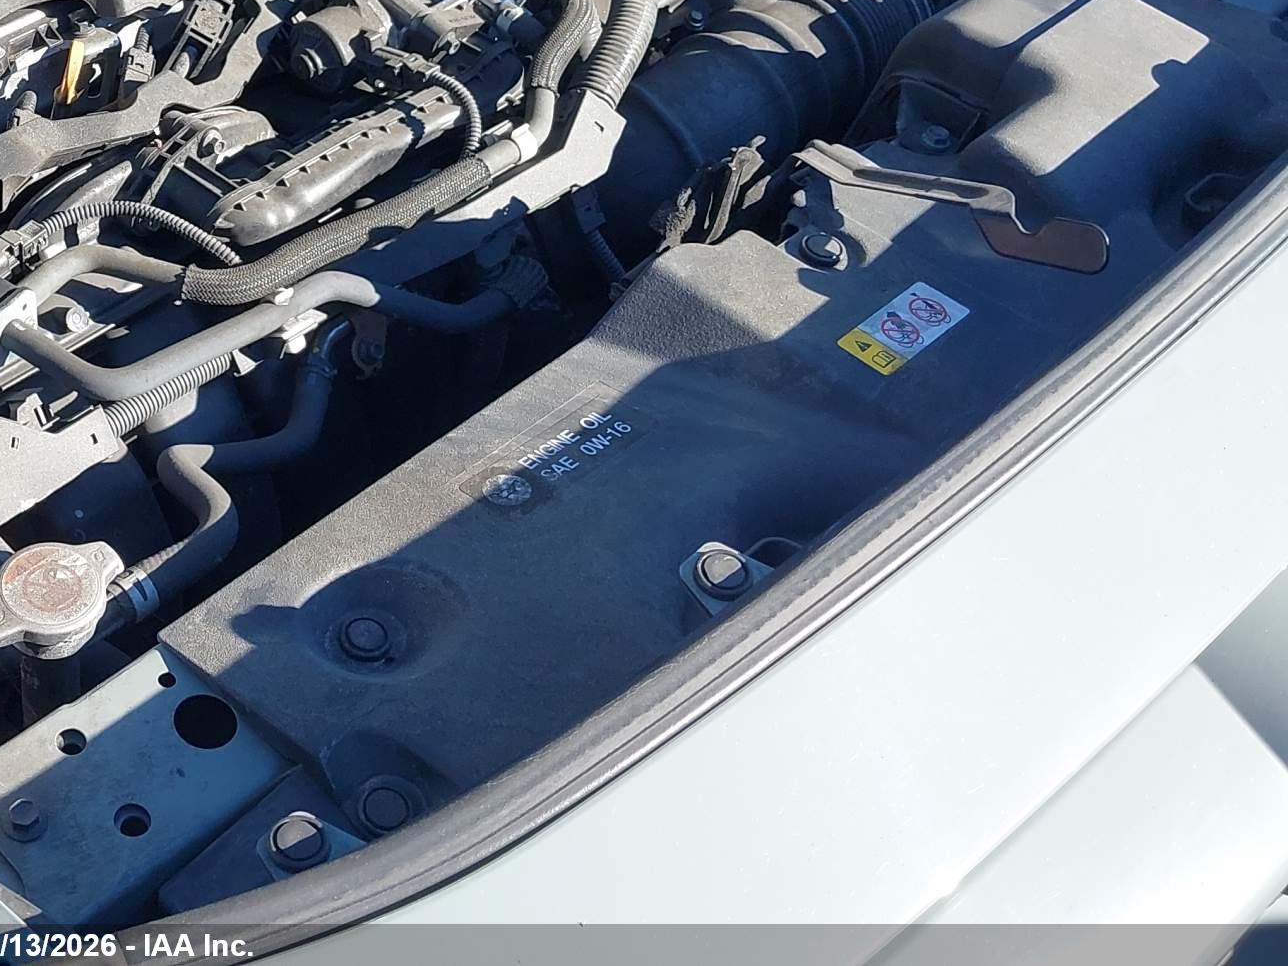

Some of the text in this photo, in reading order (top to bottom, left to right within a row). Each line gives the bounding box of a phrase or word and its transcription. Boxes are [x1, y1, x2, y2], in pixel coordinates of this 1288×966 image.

[517, 411, 612, 470] ENGINE OIL
[540, 421, 633, 482] SAE 0W-16
